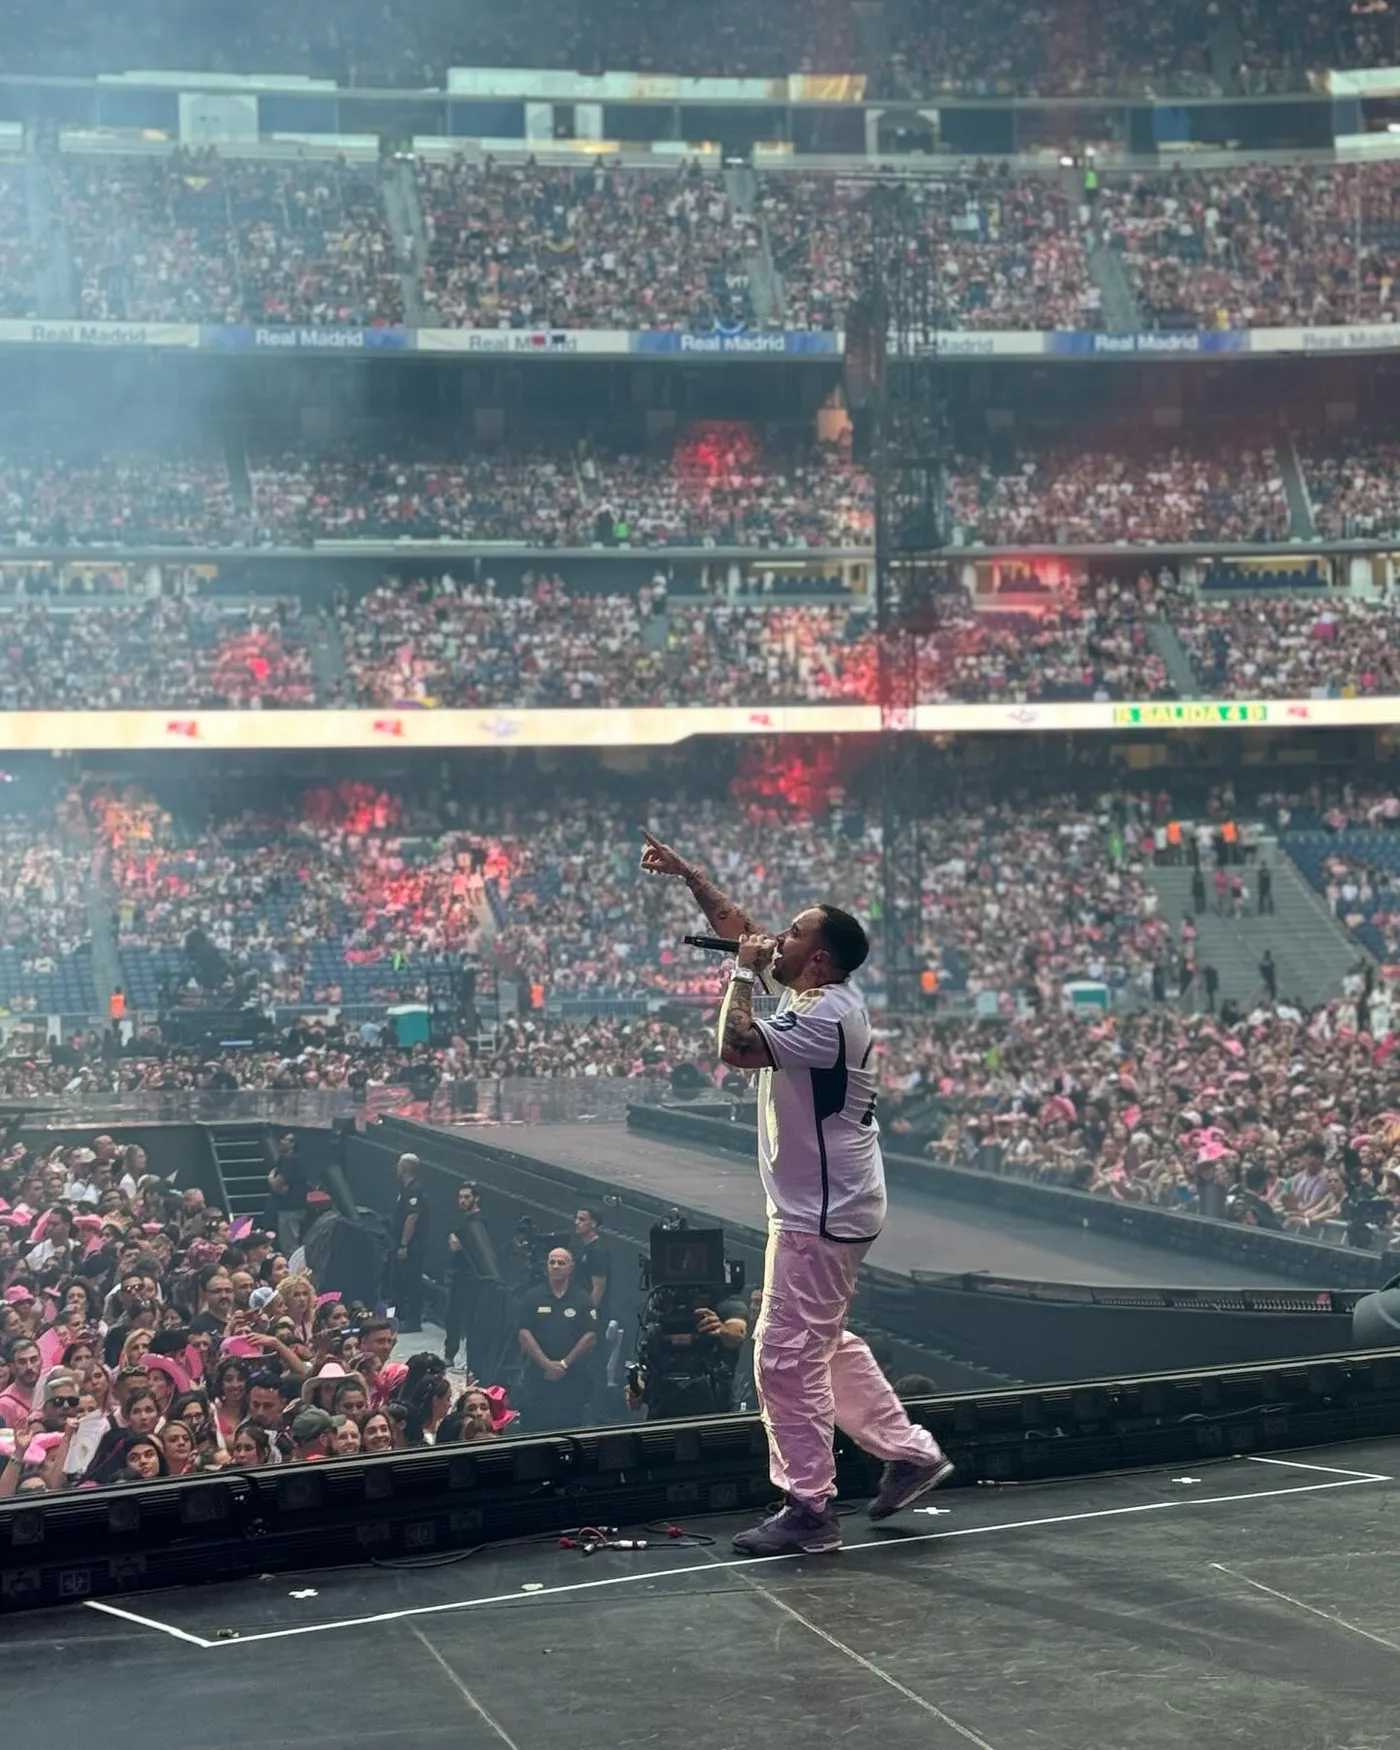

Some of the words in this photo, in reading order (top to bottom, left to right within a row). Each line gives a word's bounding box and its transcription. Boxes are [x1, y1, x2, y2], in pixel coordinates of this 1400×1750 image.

[31, 324, 74, 341] Real
[80, 325, 146, 343] Madrid
[256, 328, 296, 346] Real
[300, 328, 363, 348] Madrid
[1095, 334, 1134, 351] Real
[1138, 334, 1199, 351] Madrid
[469, 334, 508, 352] Real
[681, 334, 720, 351] Real
[724, 335, 785, 352] Madrid
